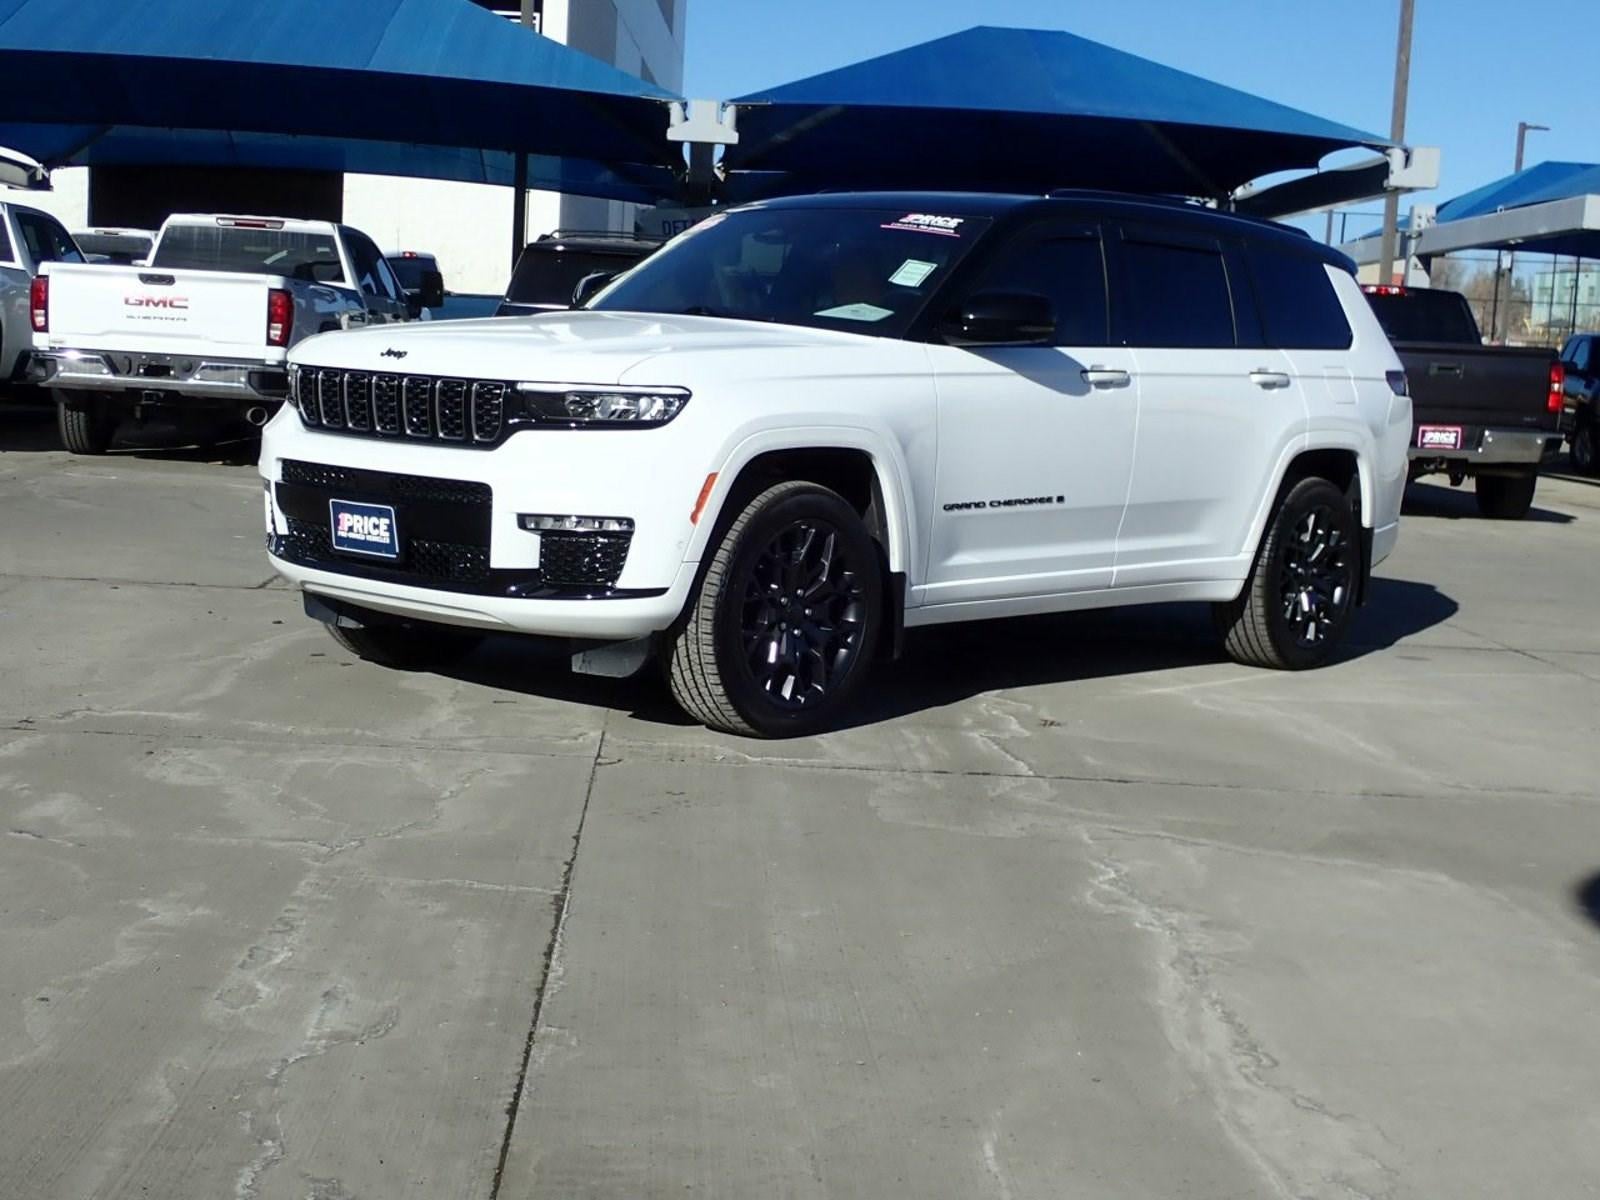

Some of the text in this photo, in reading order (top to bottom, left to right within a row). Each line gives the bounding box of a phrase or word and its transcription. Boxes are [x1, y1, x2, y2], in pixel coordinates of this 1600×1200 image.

[124, 297, 189, 309] GMC
[380, 347, 408, 360] Jeep
[943, 501, 986, 512] GRAND
[989, 496, 1054, 508] CHEROKEE
